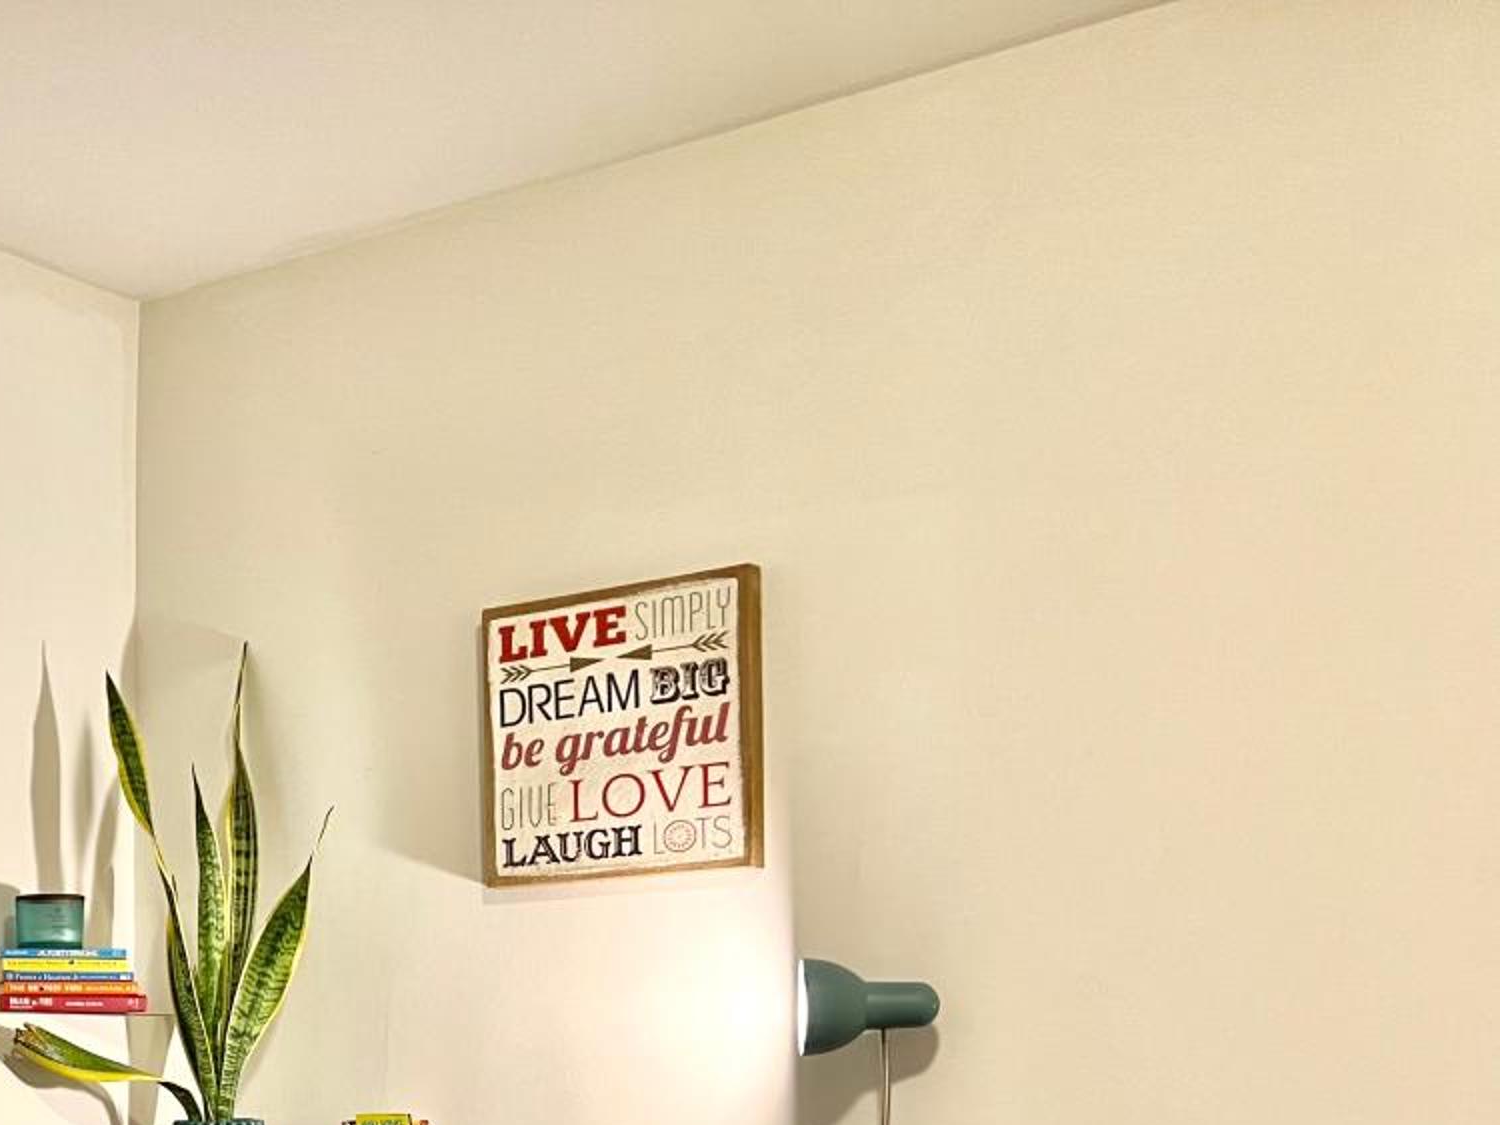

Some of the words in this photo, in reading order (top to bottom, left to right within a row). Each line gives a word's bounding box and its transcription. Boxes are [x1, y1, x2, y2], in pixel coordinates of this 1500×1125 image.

[498, 605, 627, 663] LIVE
[634, 585, 732, 641] SIMPLY
[500, 668, 641, 728] DREAM
[650, 656, 731, 705] BIG
[501, 732, 545, 771] be
[555, 702, 731, 776] grateful
[501, 781, 558, 831] GIVE
[568, 761, 732, 823] LOVE
[503, 825, 643, 868] LAUGH
[653, 815, 733, 855] LOTS
